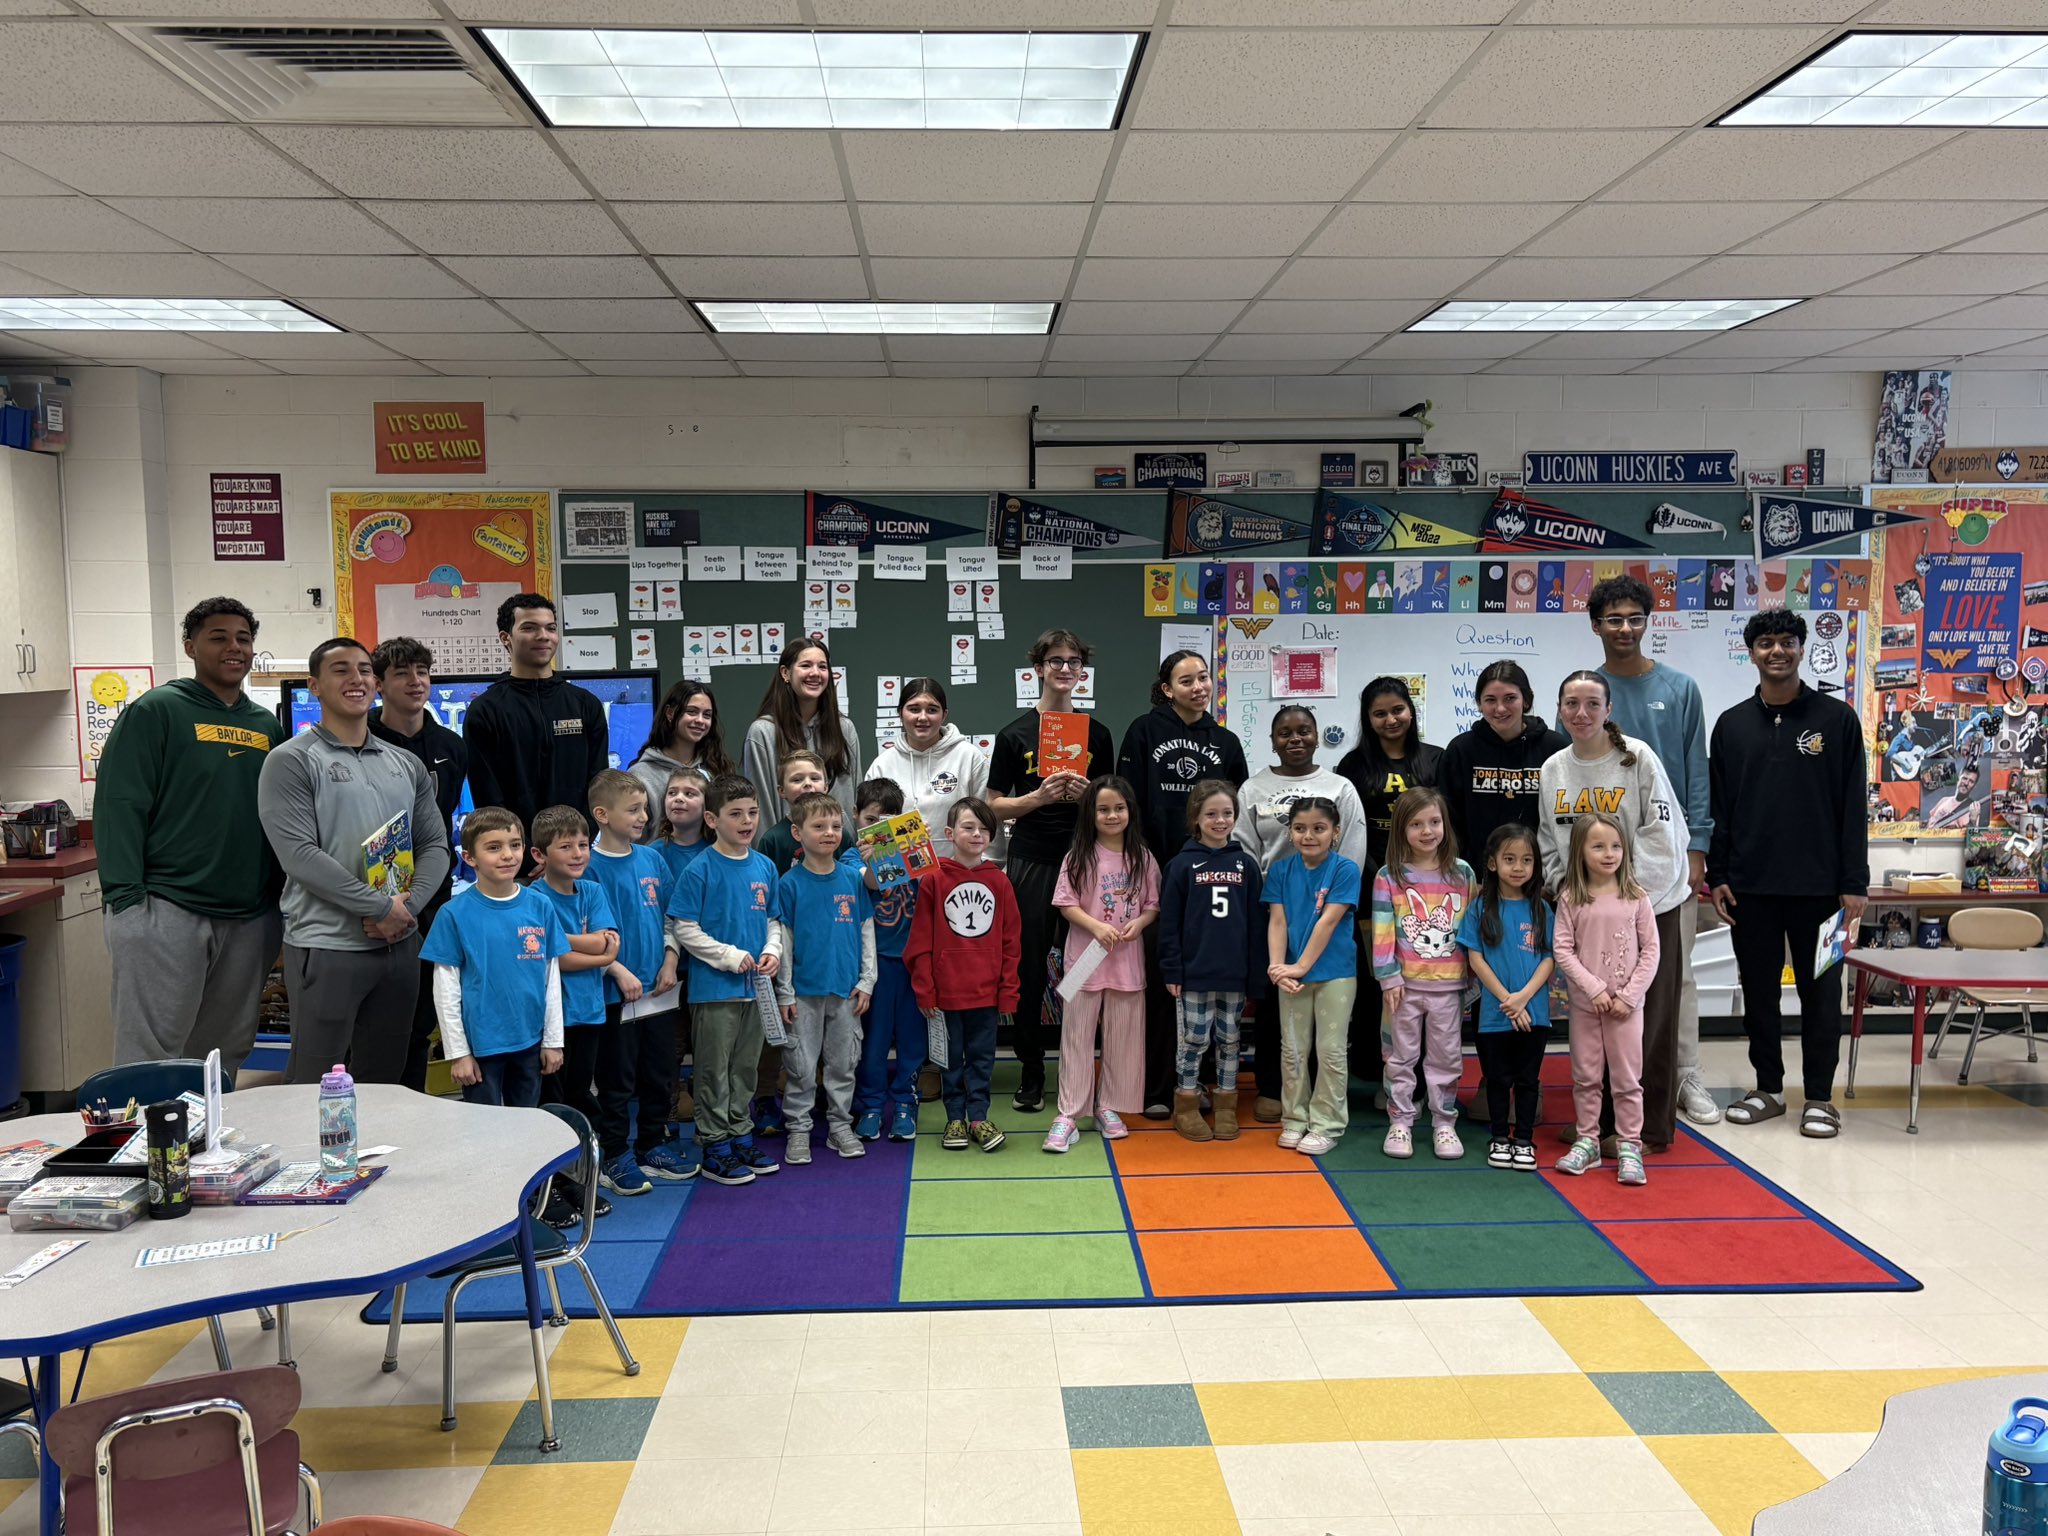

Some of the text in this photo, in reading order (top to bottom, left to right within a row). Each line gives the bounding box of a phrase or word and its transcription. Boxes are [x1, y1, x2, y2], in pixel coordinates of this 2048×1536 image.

[386, 412, 468, 433] IT'S COOL
[1904, 428, 1920, 439] USA
[386, 439, 482, 462] TO BE KIND
[1144, 459, 1197, 469] NATIONAL
[1540, 456, 1598, 482] UCONN
[1611, 455, 1685, 481] HUSKIES
[1698, 461, 1723, 475] AVE
[1137, 466, 1204, 482] CHAMPIONS
[1217, 473, 1250, 482] UCONN
[214, 481, 272, 492] YOU ARE KIND
[215, 502, 279, 512] YOU ARE SMART
[1942, 498, 2008, 514] SUPER
[645, 513, 670, 521] HUSKIES
[1812, 510, 1854, 534] UCONN
[1871, 512, 1887, 526] C
[216, 523, 251, 533] YOU ARE
[645, 521, 661, 529] HAVE
[817, 520, 869, 533] CHAMPIONS
[876, 520, 930, 535] UCONN
[1044, 518, 1096, 531] NATIONAL
[1232, 522, 1282, 531] NATIONAL
[1341, 522, 1383, 533] FINAL FOUR
[1411, 523, 1433, 533] MSP
[1676, 517, 1713, 530] UCONN
[654, 529, 671, 537] TAKES
[1025, 525, 1103, 547] CHAMPIONS
[1229, 529, 1283, 541] CHAMPIONS
[1534, 519, 1606, 545] UCONN
[1415, 533, 1441, 544] 2022
[217, 543, 265, 553] IMPORTANT
[476, 528, 527, 563] Fantastic!
[756, 551, 785, 561] Tongue
[818, 550, 847, 559] Tongue
[887, 554, 914, 564] Tongue
[755, 561, 788, 569] Between
[812, 559, 854, 569] Behind Top
[958, 556, 986, 565] Tongue
[1971, 555, 1990, 566] WHAT
[632, 561, 682, 573] Lips Together
[714, 564, 727, 574] Lip
[879, 563, 922, 572] Pulled Back
[962, 565, 983, 573] Lifted
[1035, 564, 1058, 572] Throat
[1970, 566, 1984, 578] YOU
[761, 570, 782, 578] Teeth
[822, 569, 843, 577] Teeth
[1939, 579, 1958, 591] AND
[1964, 579, 1998, 591] BELIEVE
[1998, 579, 2008, 591] IN
[1431, 600, 1444, 609] Kk
[1659, 599, 1671, 608] Ss
[1714, 598, 1728, 607] Uu
[1743, 598, 1757, 607] Vv
[1794, 595, 1808, 604] Xx
[1820, 597, 1833, 608] Yy
[1846, 597, 1859, 607] Zz
[1153, 603, 1168, 612] Aa
[1183, 601, 1197, 610] Bb
[1207, 602, 1220, 611] Cc
[1235, 601, 1250, 609] Dd
[1263, 601, 1276, 609] Ee
[1291, 601, 1301, 609] Ff
[1316, 601, 1331, 611] Gg
[1345, 601, 1360, 609] Hh
[1377, 601, 1385, 609] Ii
[1405, 601, 1413, 611] Jj
[1484, 601, 1505, 609] Mm
[1515, 601, 1530, 609] Nn
[1545, 601, 1560, 609] Oo
[1573, 600, 1586, 611] Pp
[421, 609, 482, 618] Hundreds Chart
[582, 608, 599, 617] Stop
[1939, 594, 2005, 630] LOVE.
[441, 619, 464, 627] 1-120
[1651, 615, 1682, 628] Raffle
[1302, 622, 1340, 641] Date:
[1455, 623, 1535, 648] Question
[1928, 631, 2011, 643] ONLY LOVE WILL TRULY
[579, 650, 600, 658] Nose
[1976, 644, 2010, 654] SAVE THE
[1231, 650, 1265, 661] GOOD
[1241, 682, 1263, 697] ES
[86, 701, 107, 714] Be
[216, 728, 254, 744] BAYLOR
[1151, 737, 1223, 766] JONATHAN LAW
[1472, 769, 1524, 780] JONATHAN
[1385, 772, 1409, 793] A
[1472, 777, 1541, 790] LACROSS
[1554, 786, 1626, 814] LAW
[1657, 803, 1670, 821] 13
[1195, 872, 1243, 883] BUECKERS
[947, 889, 993, 915] THING
[1211, 886, 1229, 918] 5
[965, 911, 977, 930] 1
